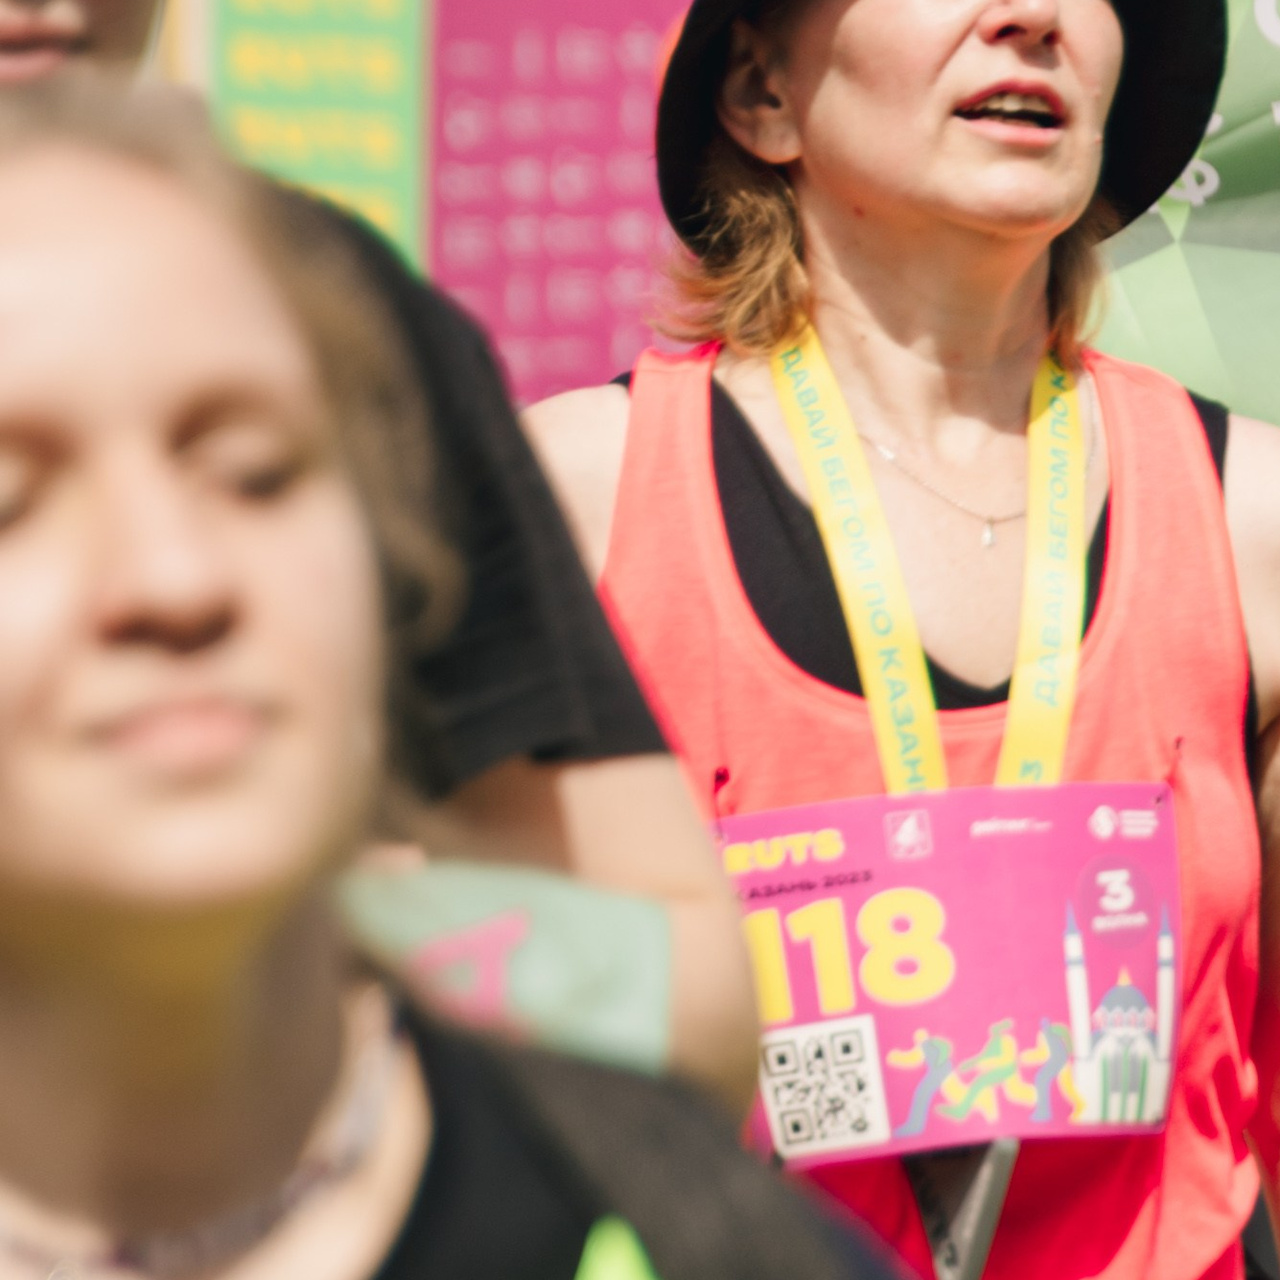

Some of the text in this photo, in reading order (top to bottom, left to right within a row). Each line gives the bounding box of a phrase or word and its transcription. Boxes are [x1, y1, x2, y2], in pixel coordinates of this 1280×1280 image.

[1049, 392, 1071, 443] ПО
[1048, 448, 1071, 563] БЕГОМ
[778, 346, 930, 795] ДАВАЙ БЕГОМ ПО КАЗАН
[1033, 568, 1069, 708] ДАВАЙ
[1095, 868, 1136, 913] 3
